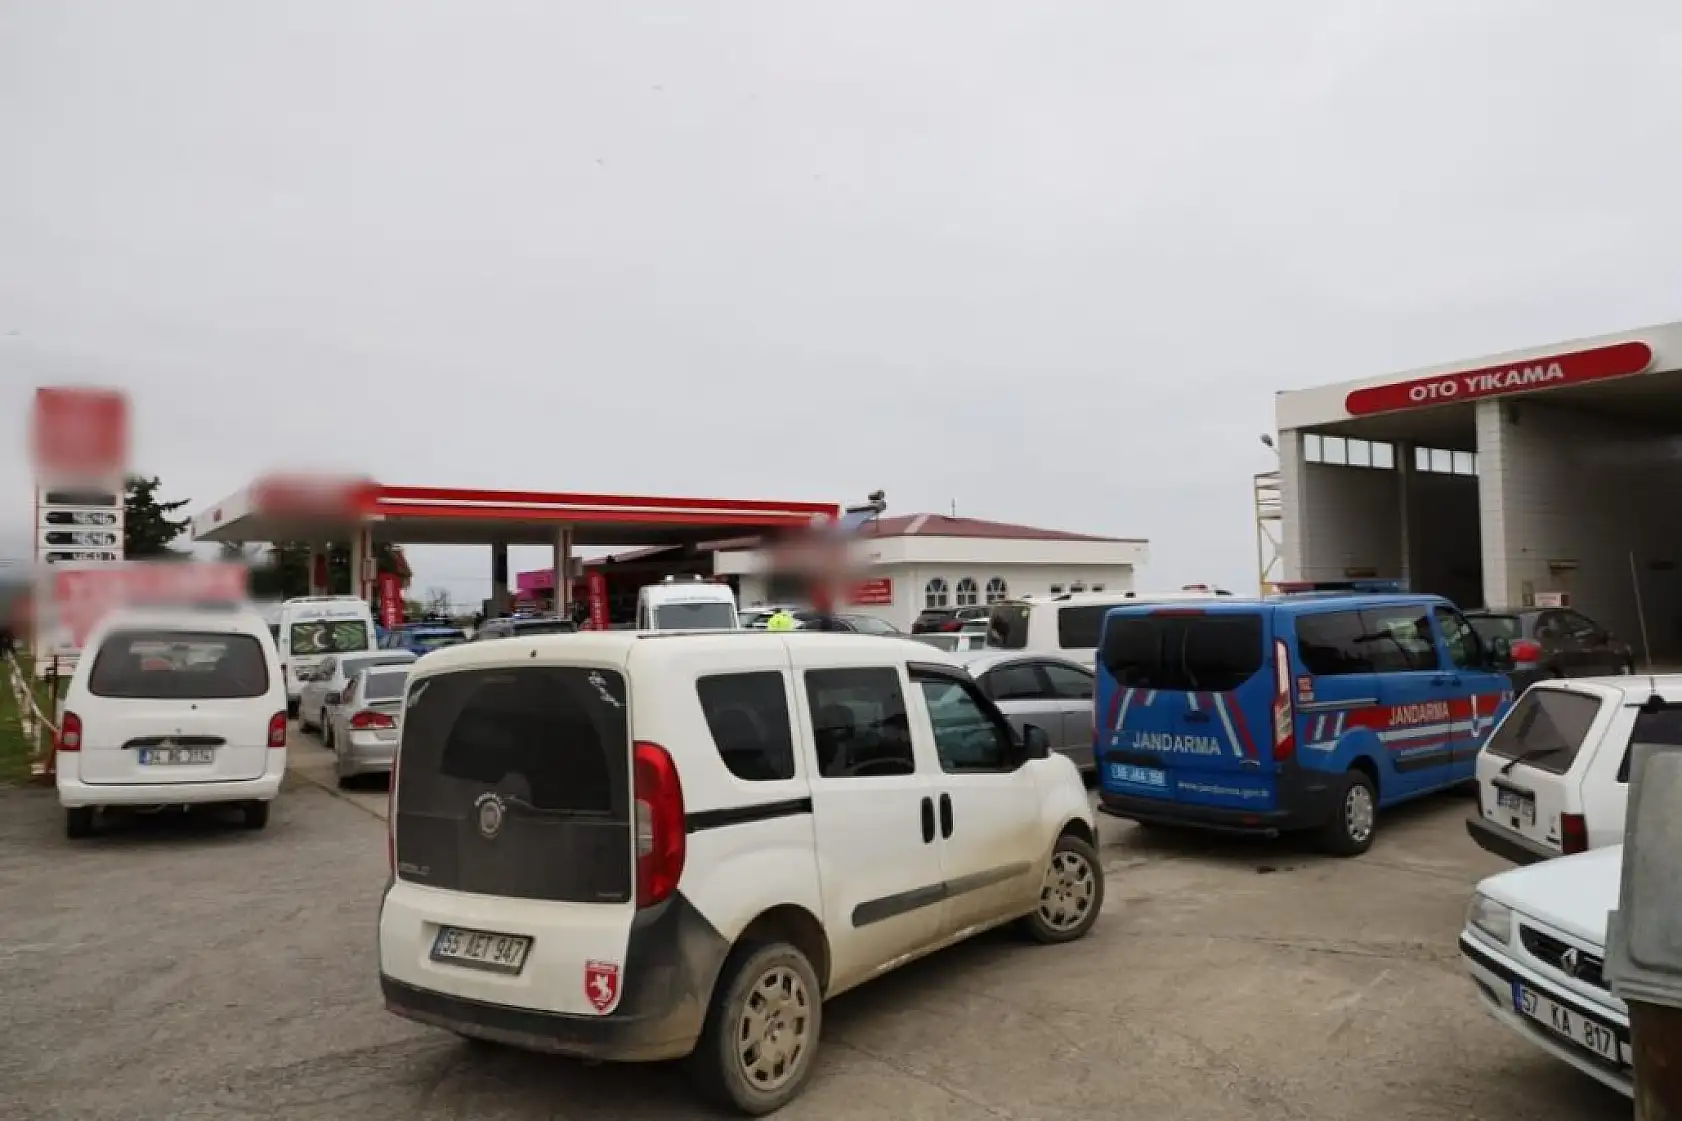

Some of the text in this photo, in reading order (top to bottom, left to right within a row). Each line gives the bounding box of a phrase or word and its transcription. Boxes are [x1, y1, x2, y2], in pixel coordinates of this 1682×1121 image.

[1408, 362, 1564, 401] OTO YIKAMA
[1389, 700, 1450, 725] JANDARMA
[1132, 732, 1221, 755] JANDARMA
[465, 934, 493, 958] AET
[495, 938, 523, 963] 947
[1522, 987, 1611, 1054] 57 KA 817
